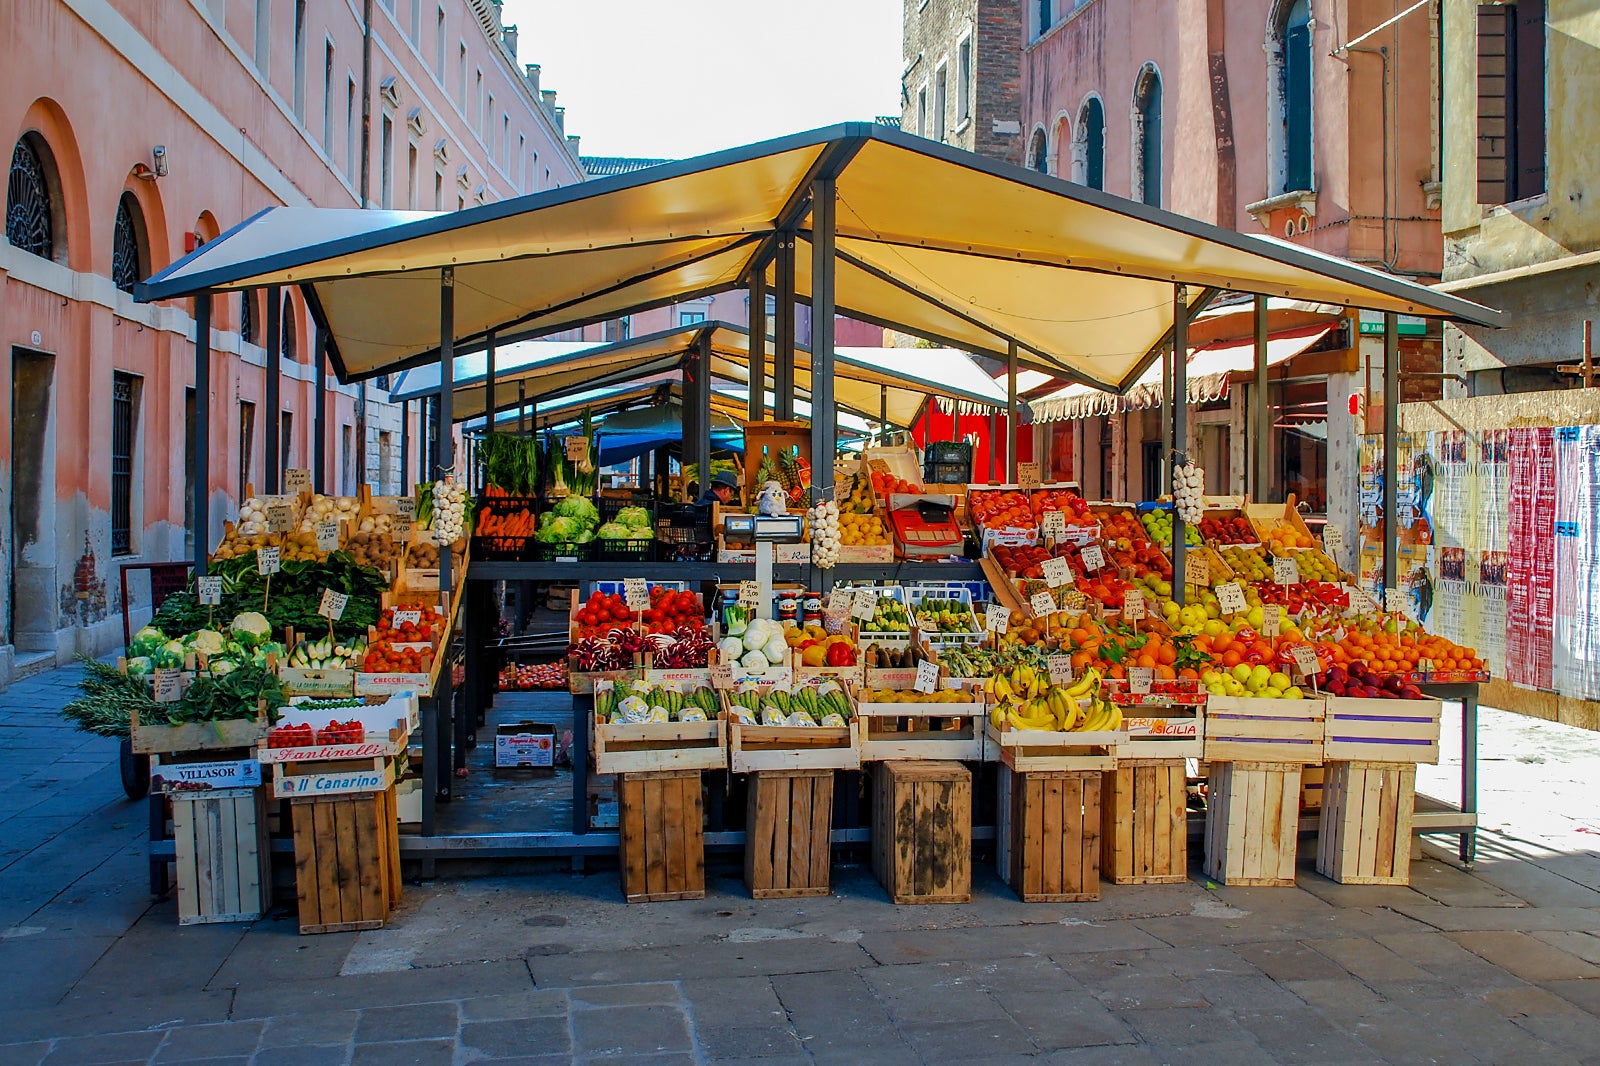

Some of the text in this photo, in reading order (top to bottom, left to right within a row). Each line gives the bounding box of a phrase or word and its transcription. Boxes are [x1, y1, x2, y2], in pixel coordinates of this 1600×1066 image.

[1433, 577, 1472, 596] CONCERTO
[1055, 667, 1070, 675] 2,00
[1155, 725, 1197, 735] SICILIA
[275, 744, 383, 761] Fantinelli
[179, 767, 236, 780] VILLASOR
[315, 775, 379, 790] Canarino
